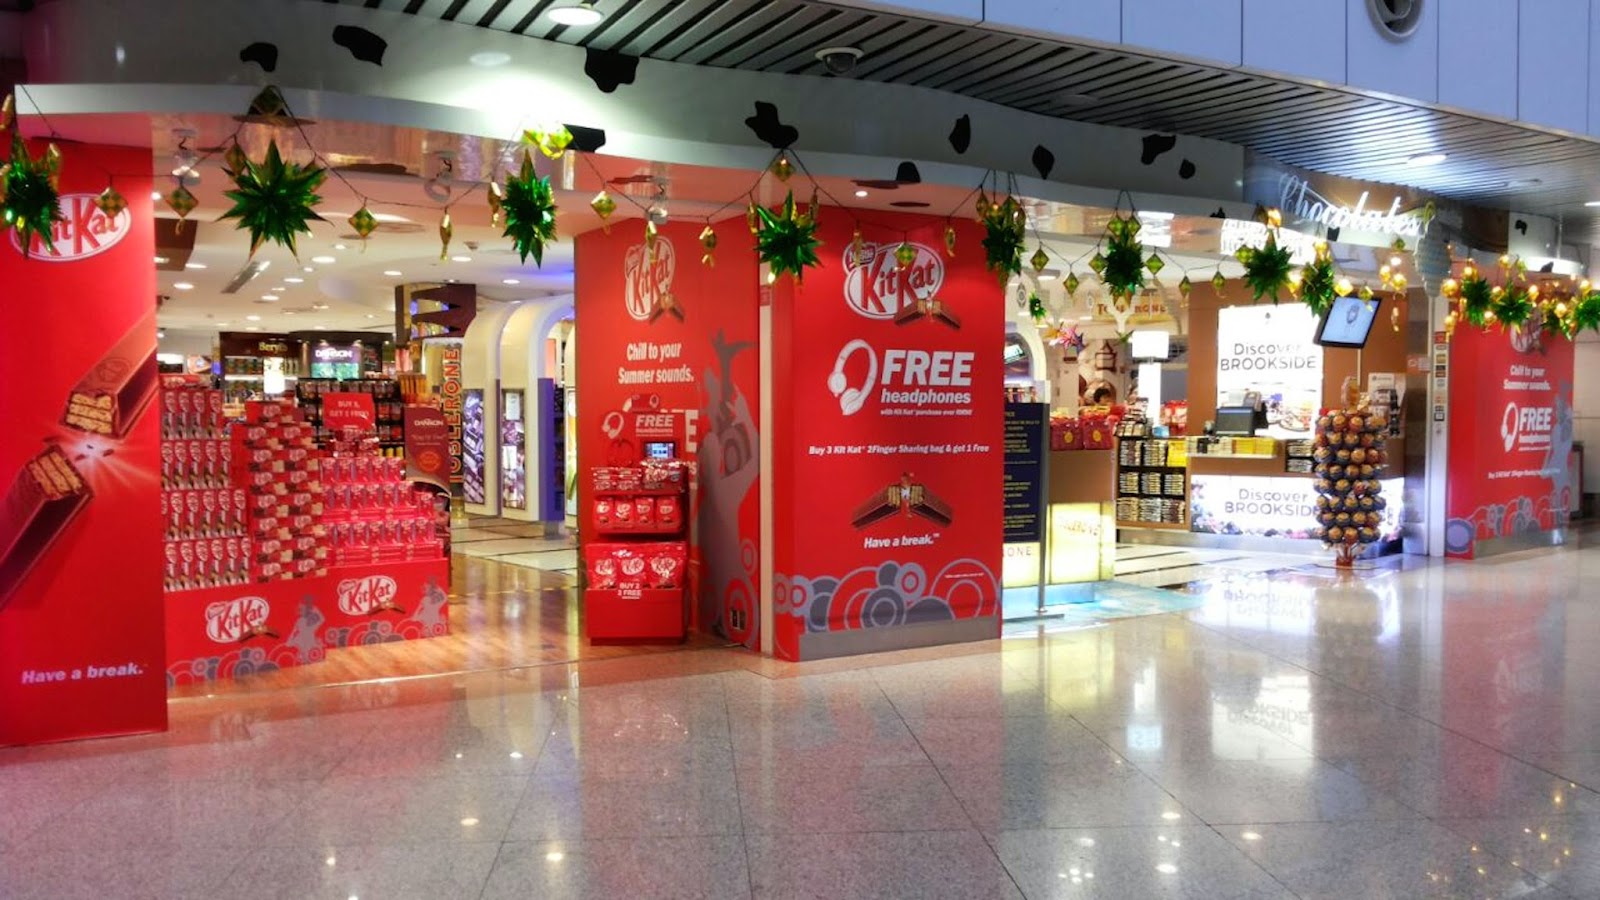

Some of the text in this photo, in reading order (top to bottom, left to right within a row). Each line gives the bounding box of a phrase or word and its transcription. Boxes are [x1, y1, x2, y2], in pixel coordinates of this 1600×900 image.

[1278, 173, 1420, 237] Chocolates
[861, 247, 936, 313] KitKat
[627, 342, 682, 363] Chill to your
[618, 364, 694, 384] Summer sounds.
[881, 349, 975, 386] FREE
[1220, 356, 1317, 371] BROOKSIDE
[881, 388, 971, 406] headphones
[635, 414, 674, 427] FREE
[1519, 407, 1552, 431] FREE
[809, 445, 825, 455] Buy
[826, 446, 832, 454] 3
[834, 446, 846, 454] Kit
[867, 445, 897, 455] 2Finger
[898, 445, 929, 454] Sharing
[930, 445, 944, 454] bag
[945, 444, 951, 453] &
[953, 445, 966, 454] get
[973, 444, 990, 452] Free
[1238, 488, 1308, 501] Discover
[864, 537, 890, 548] Have
[892, 538, 899, 546] a
[348, 578, 392, 613] KitKat
[217, 602, 263, 640] KitKat
[22, 662, 143, 684] Have a break.
